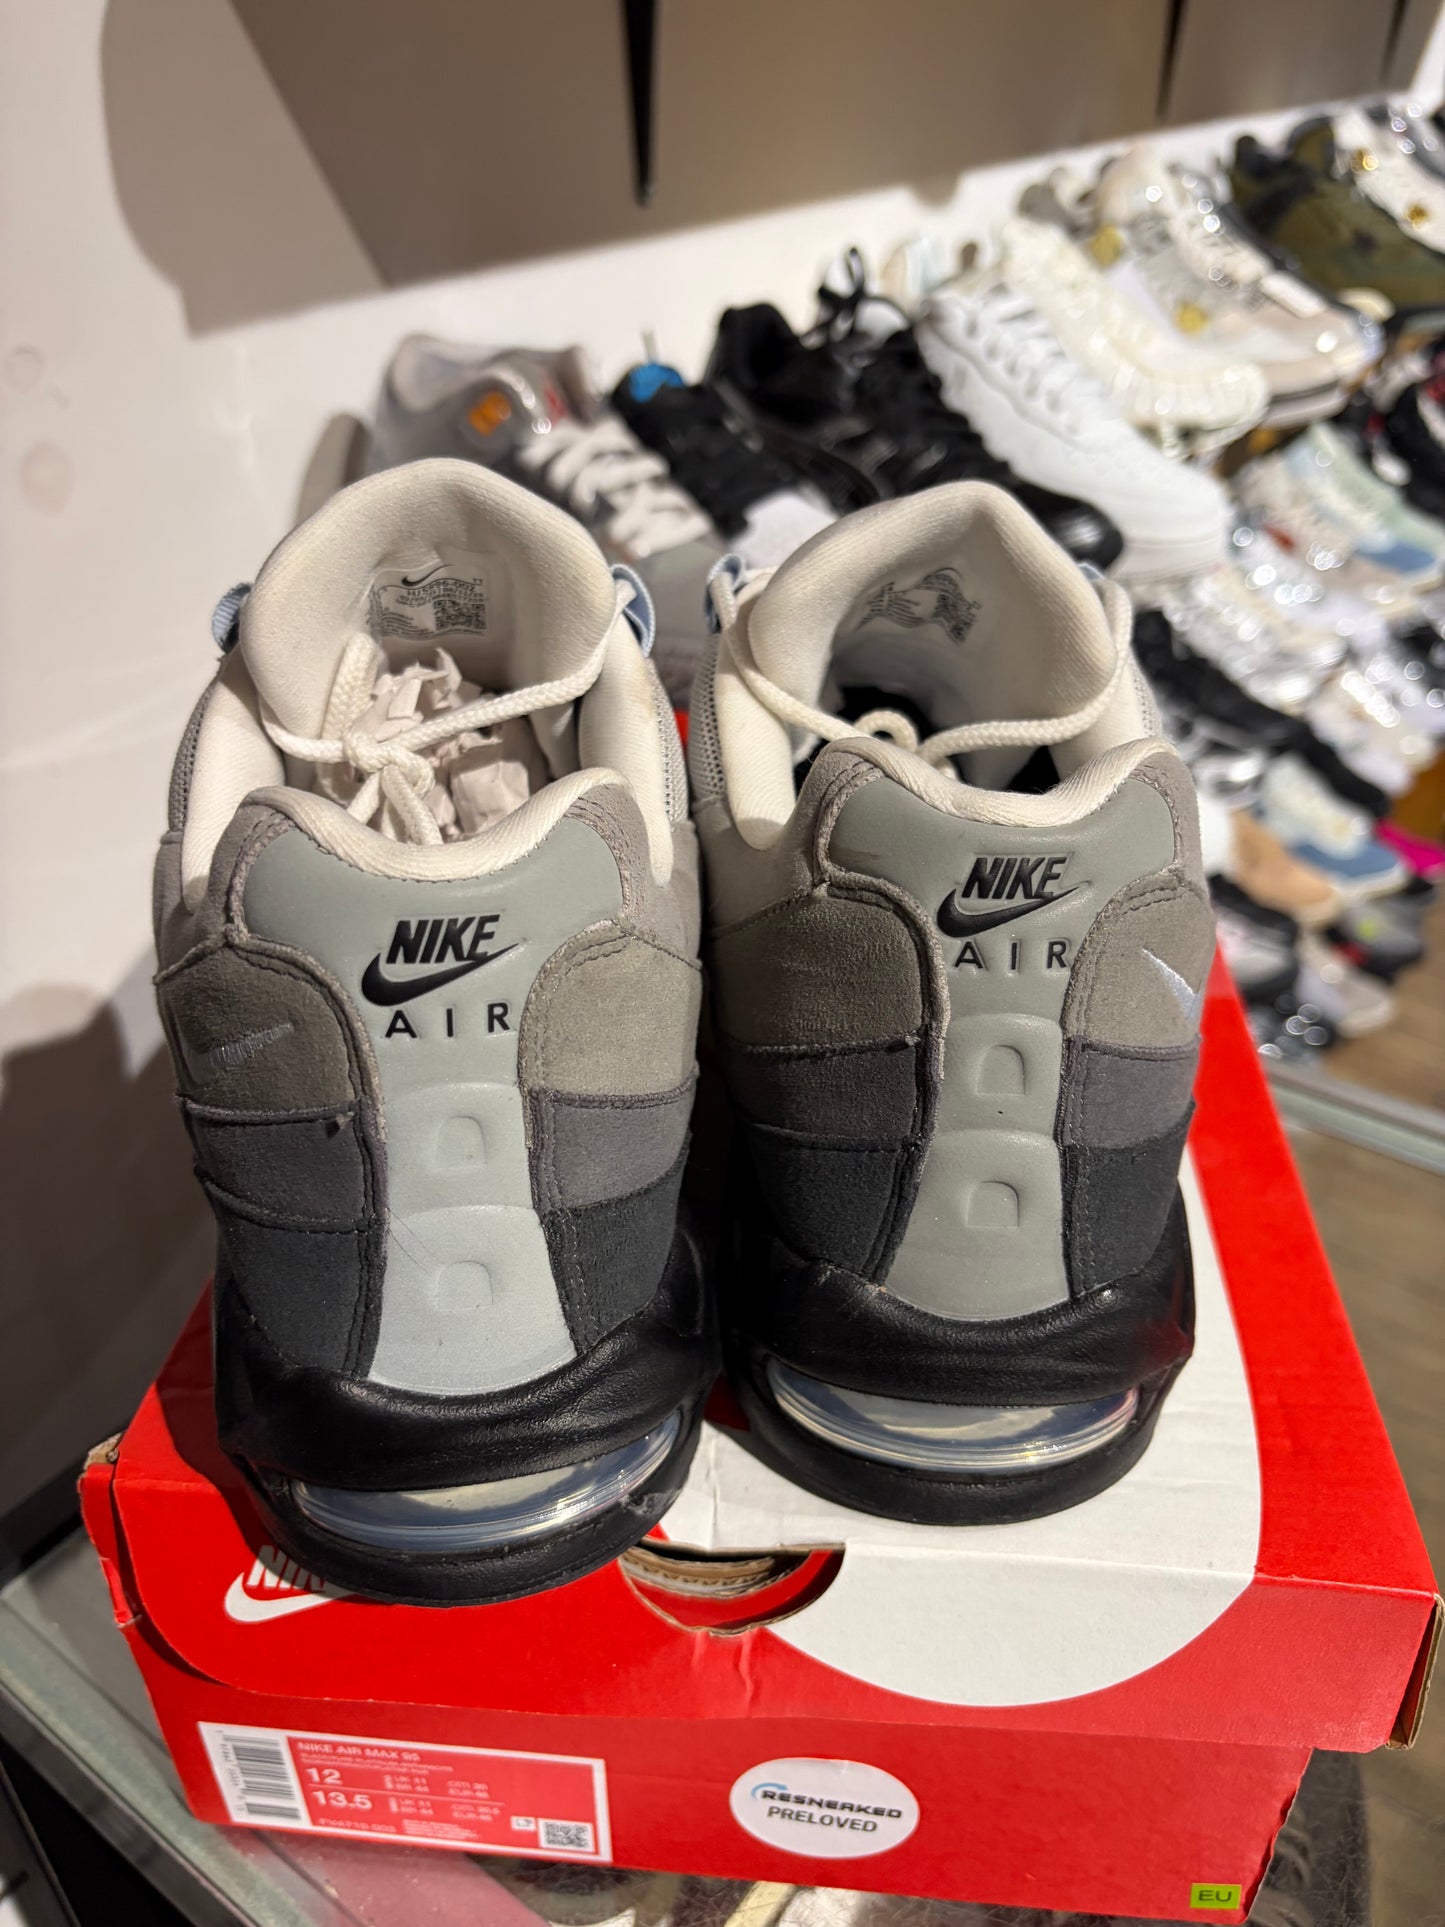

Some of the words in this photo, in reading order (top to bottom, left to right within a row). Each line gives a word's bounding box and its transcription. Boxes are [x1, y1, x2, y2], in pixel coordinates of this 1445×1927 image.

[961, 856, 1068, 900] NIKE
[386, 913, 502, 965] NIKE
[954, 940, 1068, 970] AIR
[385, 1003, 510, 1039] AIR
[297, 1742, 333, 1753] NIKE
[336, 1746, 362, 1756] AIR
[364, 1748, 399, 1760] MAX
[305, 1768, 342, 1785] 12
[312, 1791, 373, 1811] 13.5
[761, 1789, 903, 1819] RESNEAKED
[766, 1805, 878, 1832] PRELOVED
[1198, 1888, 1232, 1903] EU
